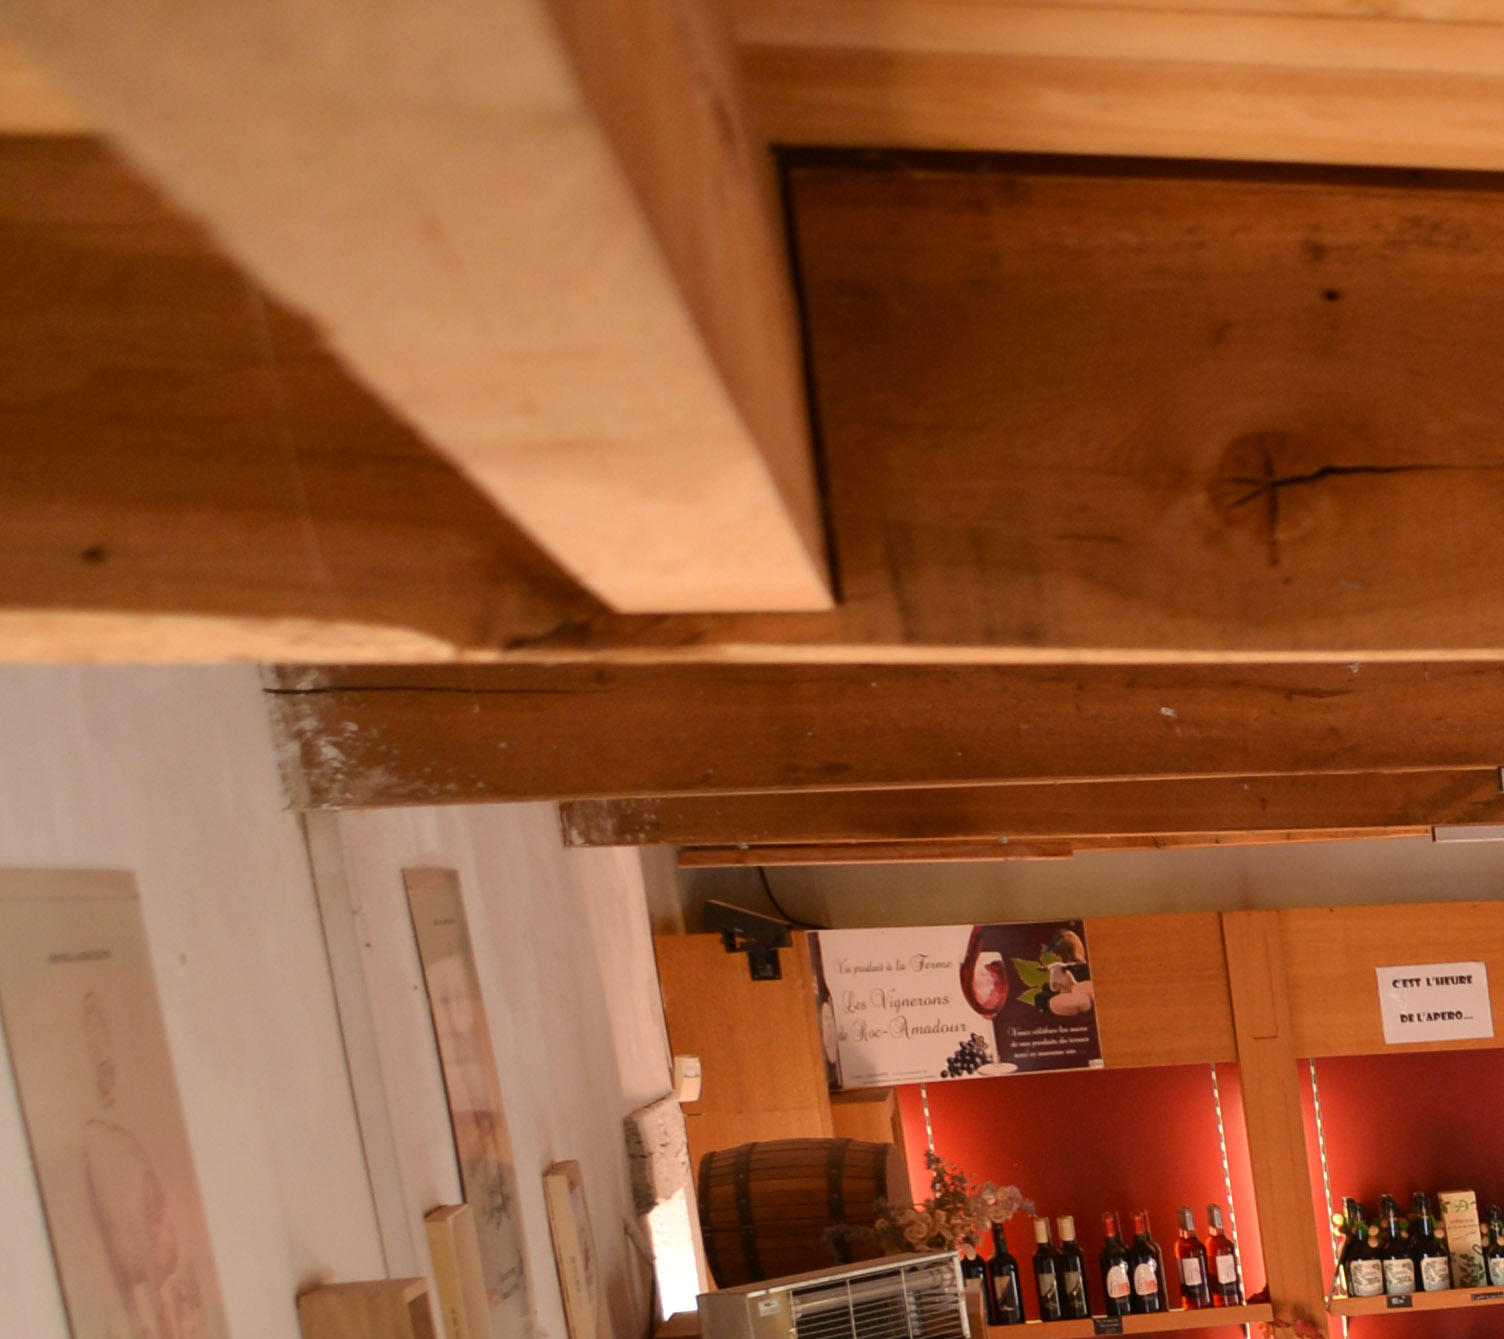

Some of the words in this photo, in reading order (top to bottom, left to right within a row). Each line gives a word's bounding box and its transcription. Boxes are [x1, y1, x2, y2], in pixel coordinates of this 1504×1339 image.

[910, 954, 953, 972] Ferme
[1392, 977, 1421, 989] C'EST
[1425, 975, 1473, 987] L'HEURE
[844, 993, 867, 1013] Les
[871, 988, 950, 1012] Vignerons
[1400, 1013, 1414, 1023] DE
[852, 1016, 967, 1042] Roc-Amadour
